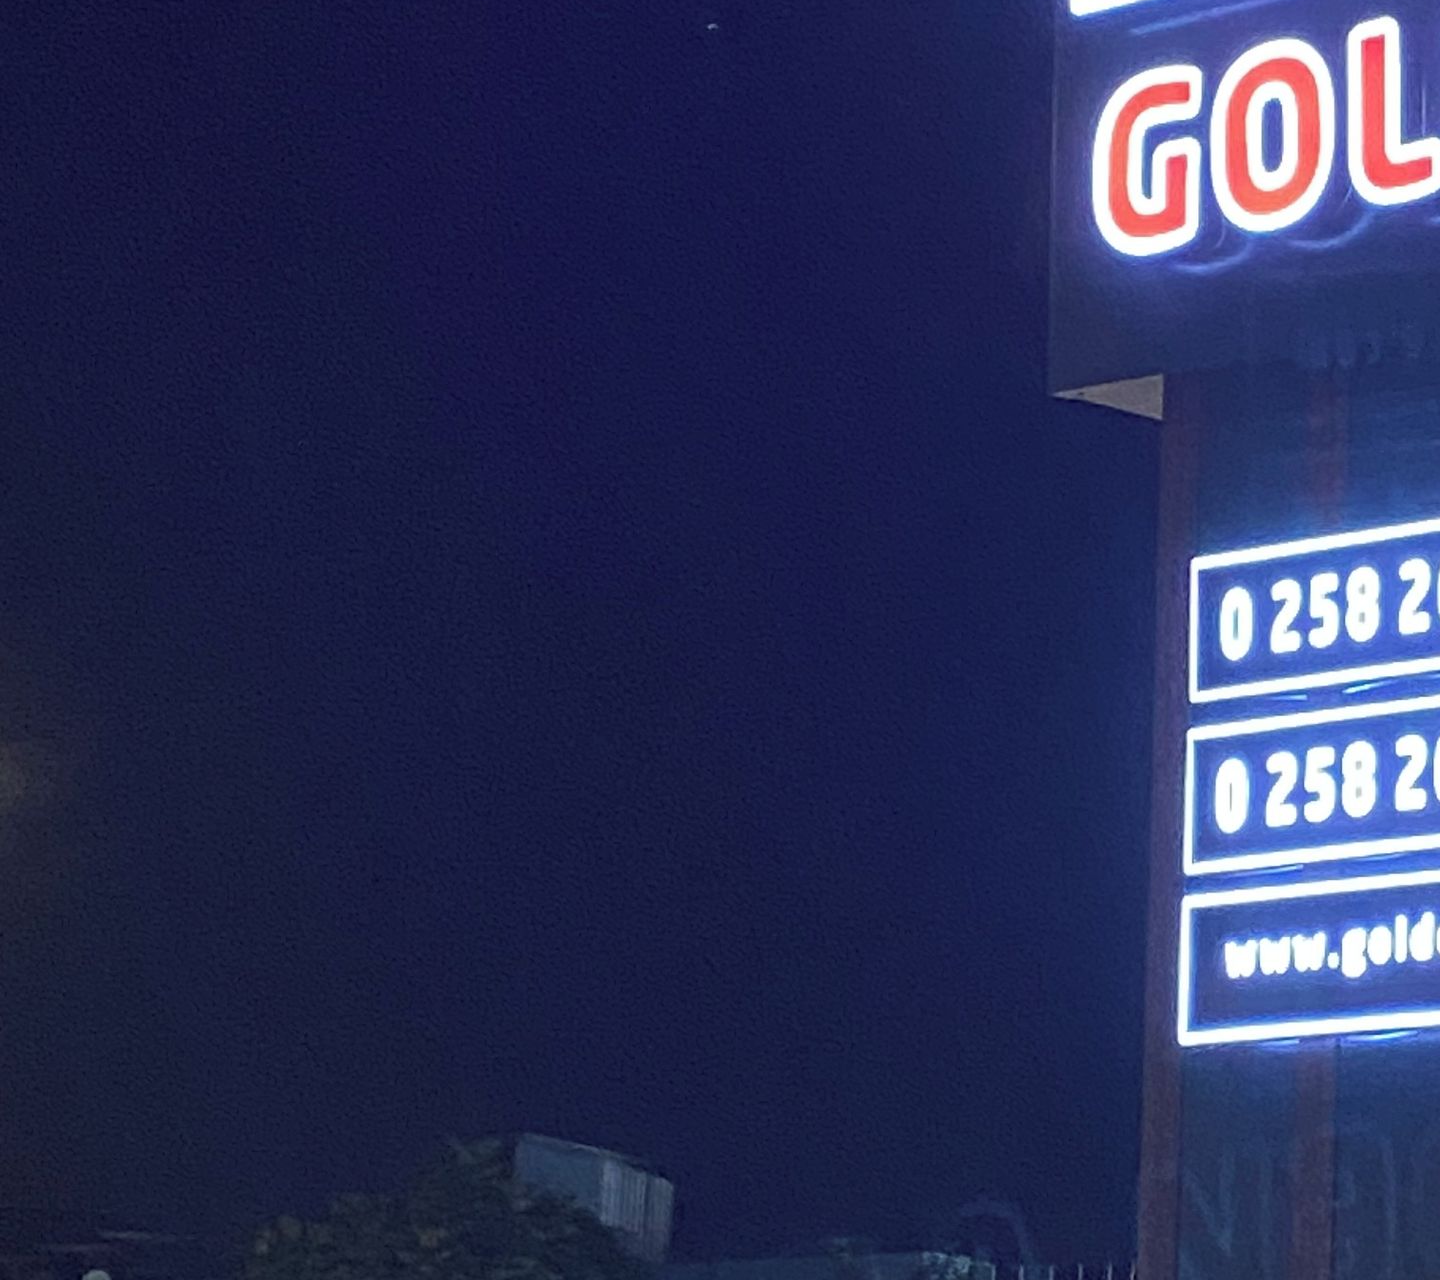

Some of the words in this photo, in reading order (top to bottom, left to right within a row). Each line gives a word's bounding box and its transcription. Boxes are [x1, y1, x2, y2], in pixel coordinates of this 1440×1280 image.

[1219, 586, 1254, 662] 0
[1268, 565, 1381, 654] 258
[1214, 757, 1250, 834] 0
[1265, 740, 1377, 828] 258
